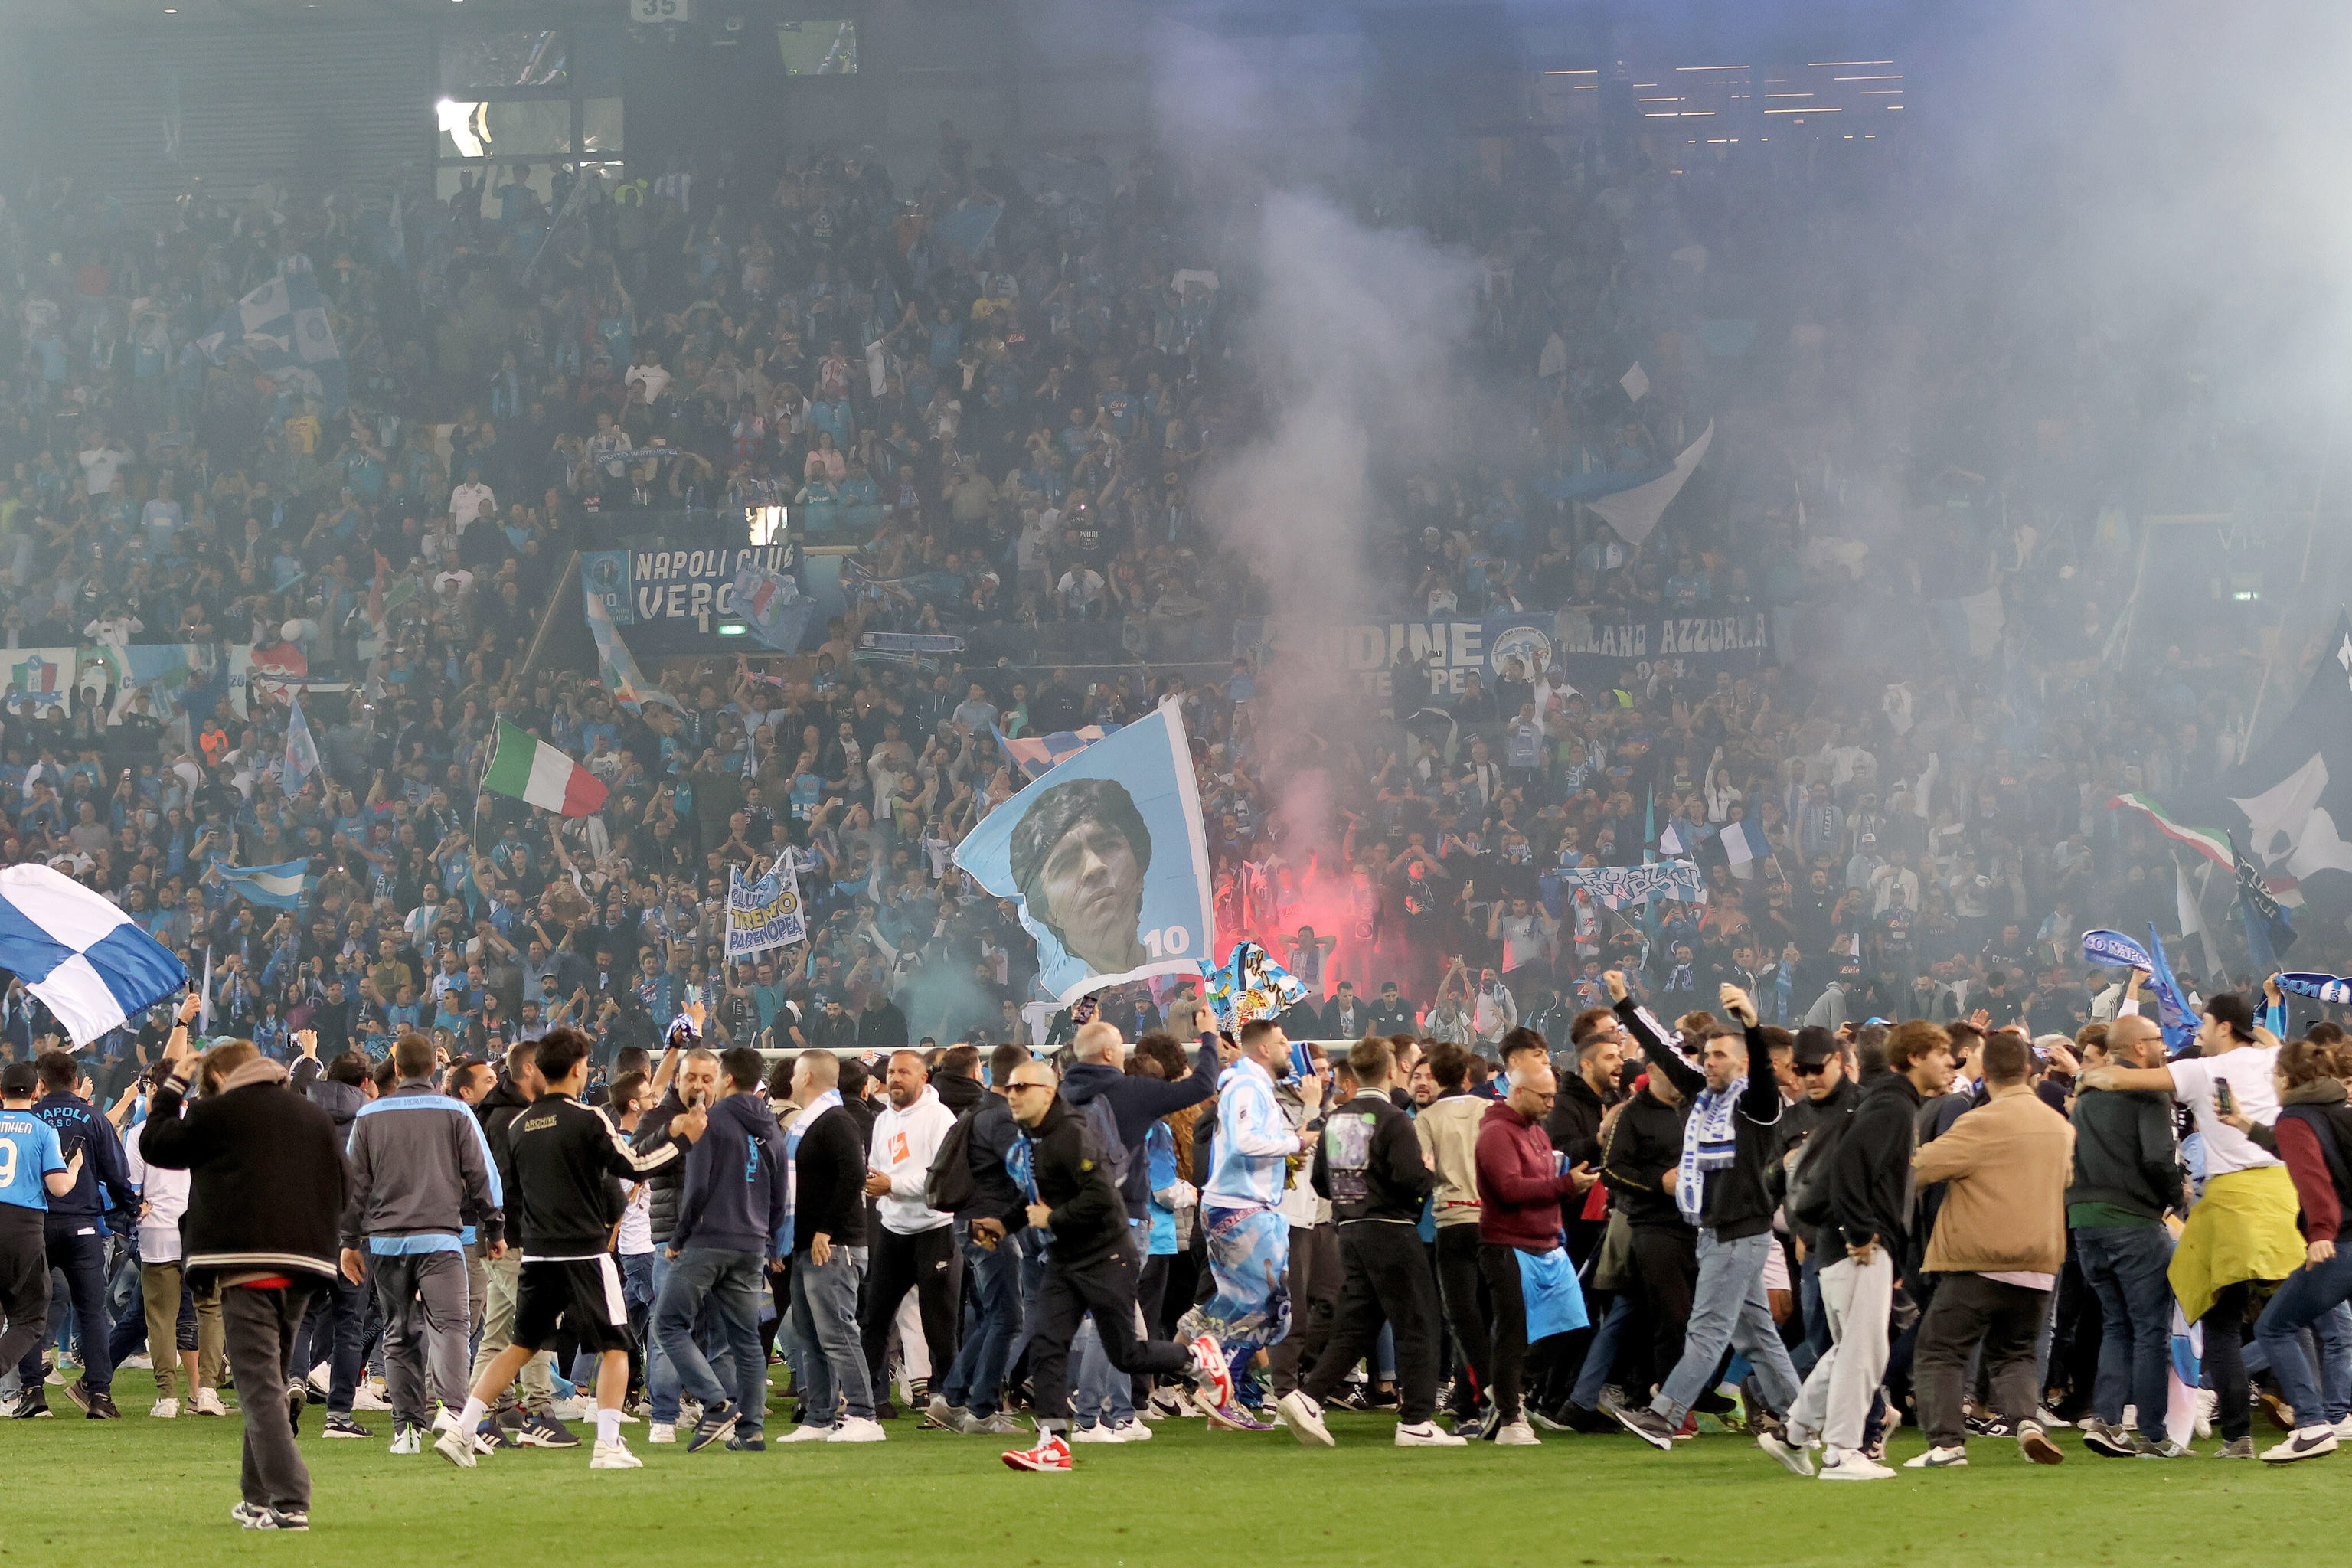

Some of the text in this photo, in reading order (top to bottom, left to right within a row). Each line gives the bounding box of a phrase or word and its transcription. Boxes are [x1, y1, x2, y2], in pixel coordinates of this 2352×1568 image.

[642, 0, 676, 15] 35
[635, 549, 727, 581] NAPOLI
[1345, 622, 1484, 670] DINE
[1142, 925, 1189, 958] 10
[0, 1121, 33, 1134] MHEN
[524, 1114, 558, 1129] ARCHIVE
[0, 1138, 18, 1188] 9
